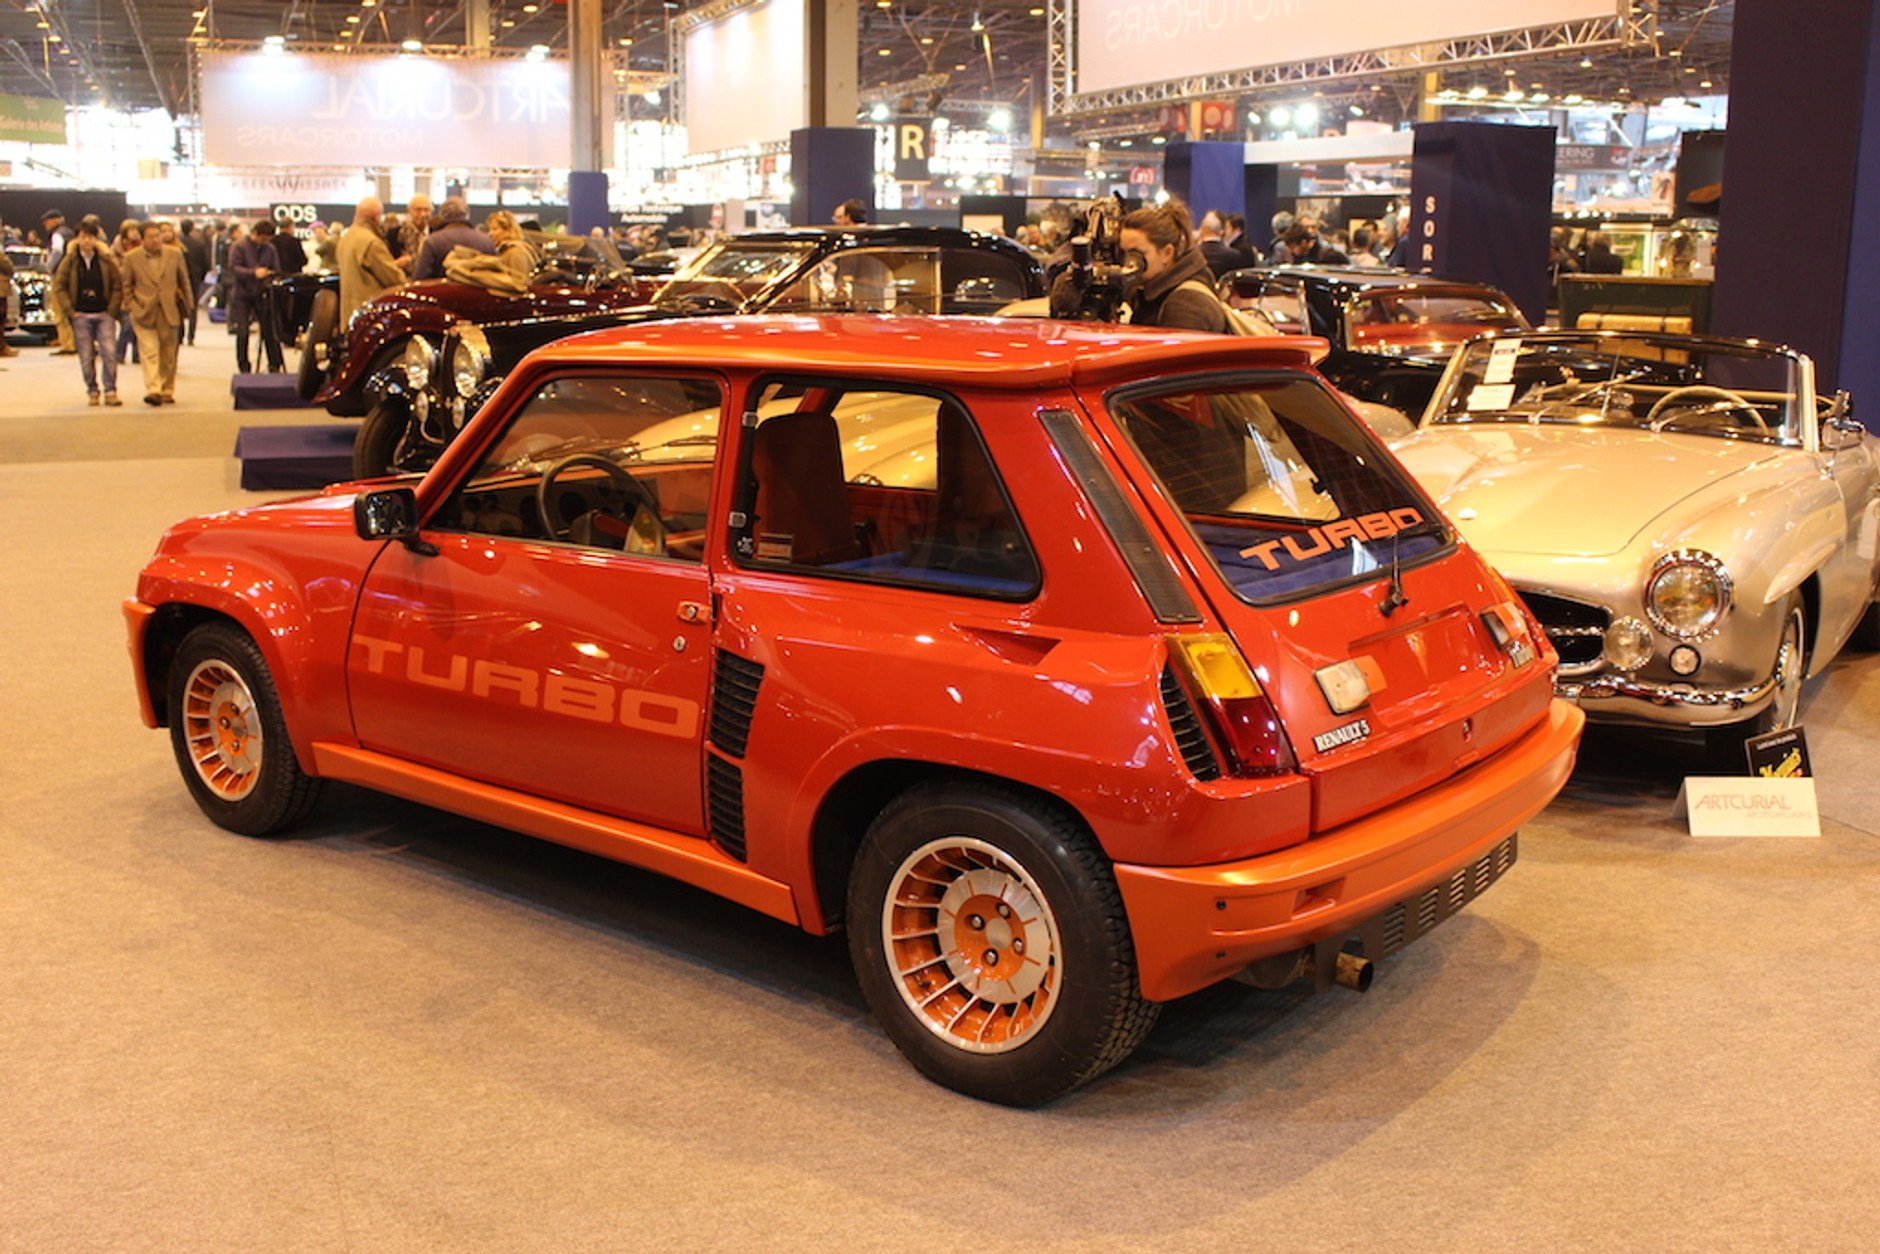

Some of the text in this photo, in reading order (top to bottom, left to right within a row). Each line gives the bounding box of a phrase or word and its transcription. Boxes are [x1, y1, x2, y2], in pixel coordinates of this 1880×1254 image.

[901, 124, 925, 160] R
[1240, 507, 1424, 571] TURBO
[352, 635, 700, 739] TURBO
[1315, 722, 1361, 752] RENAULT
[1695, 793, 1792, 810] ARTCURIAL
